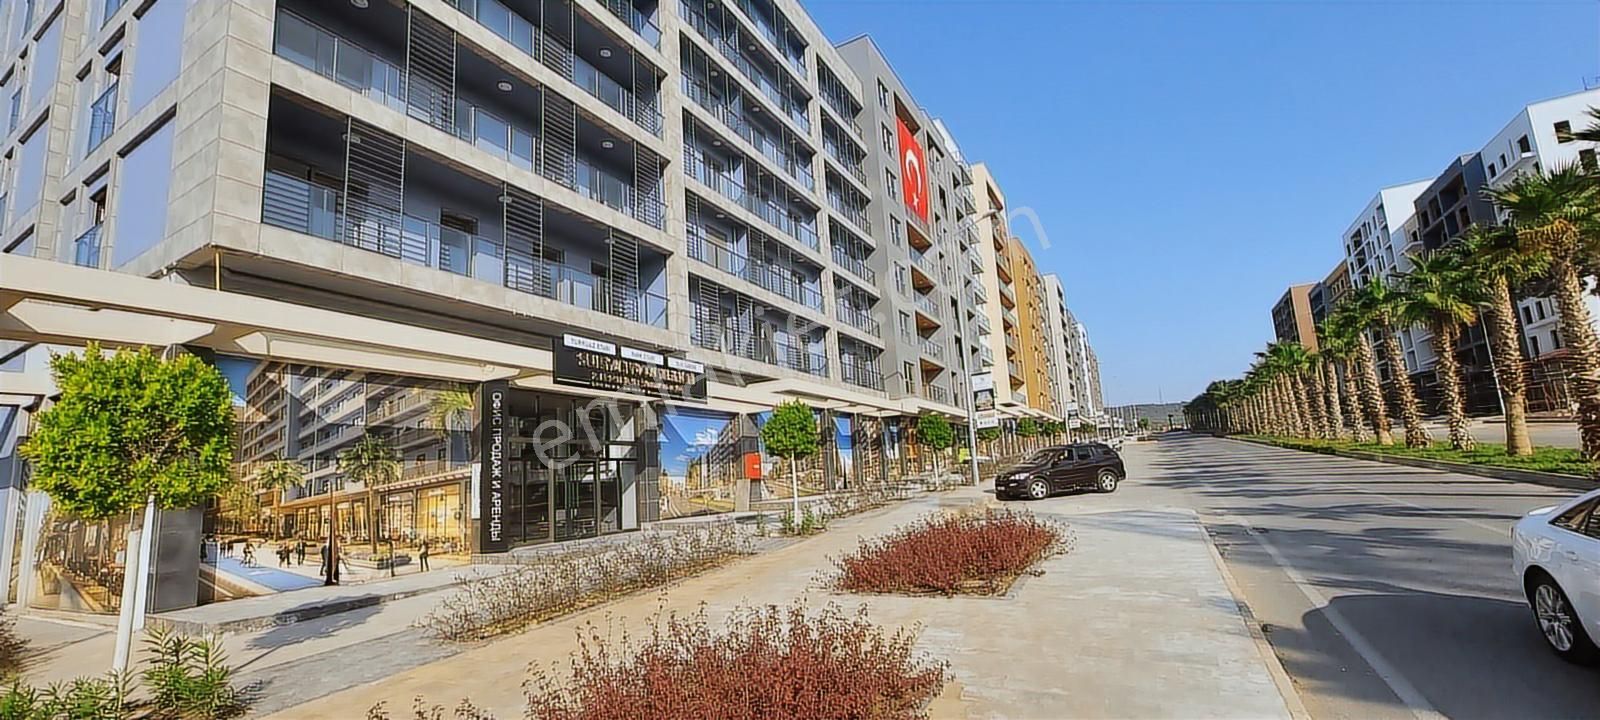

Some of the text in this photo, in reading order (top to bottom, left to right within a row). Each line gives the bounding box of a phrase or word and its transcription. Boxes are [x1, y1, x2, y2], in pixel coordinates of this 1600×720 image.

[489, 392, 503, 542] ОФИС ПРОДАЖ И АРЕНДЫ
